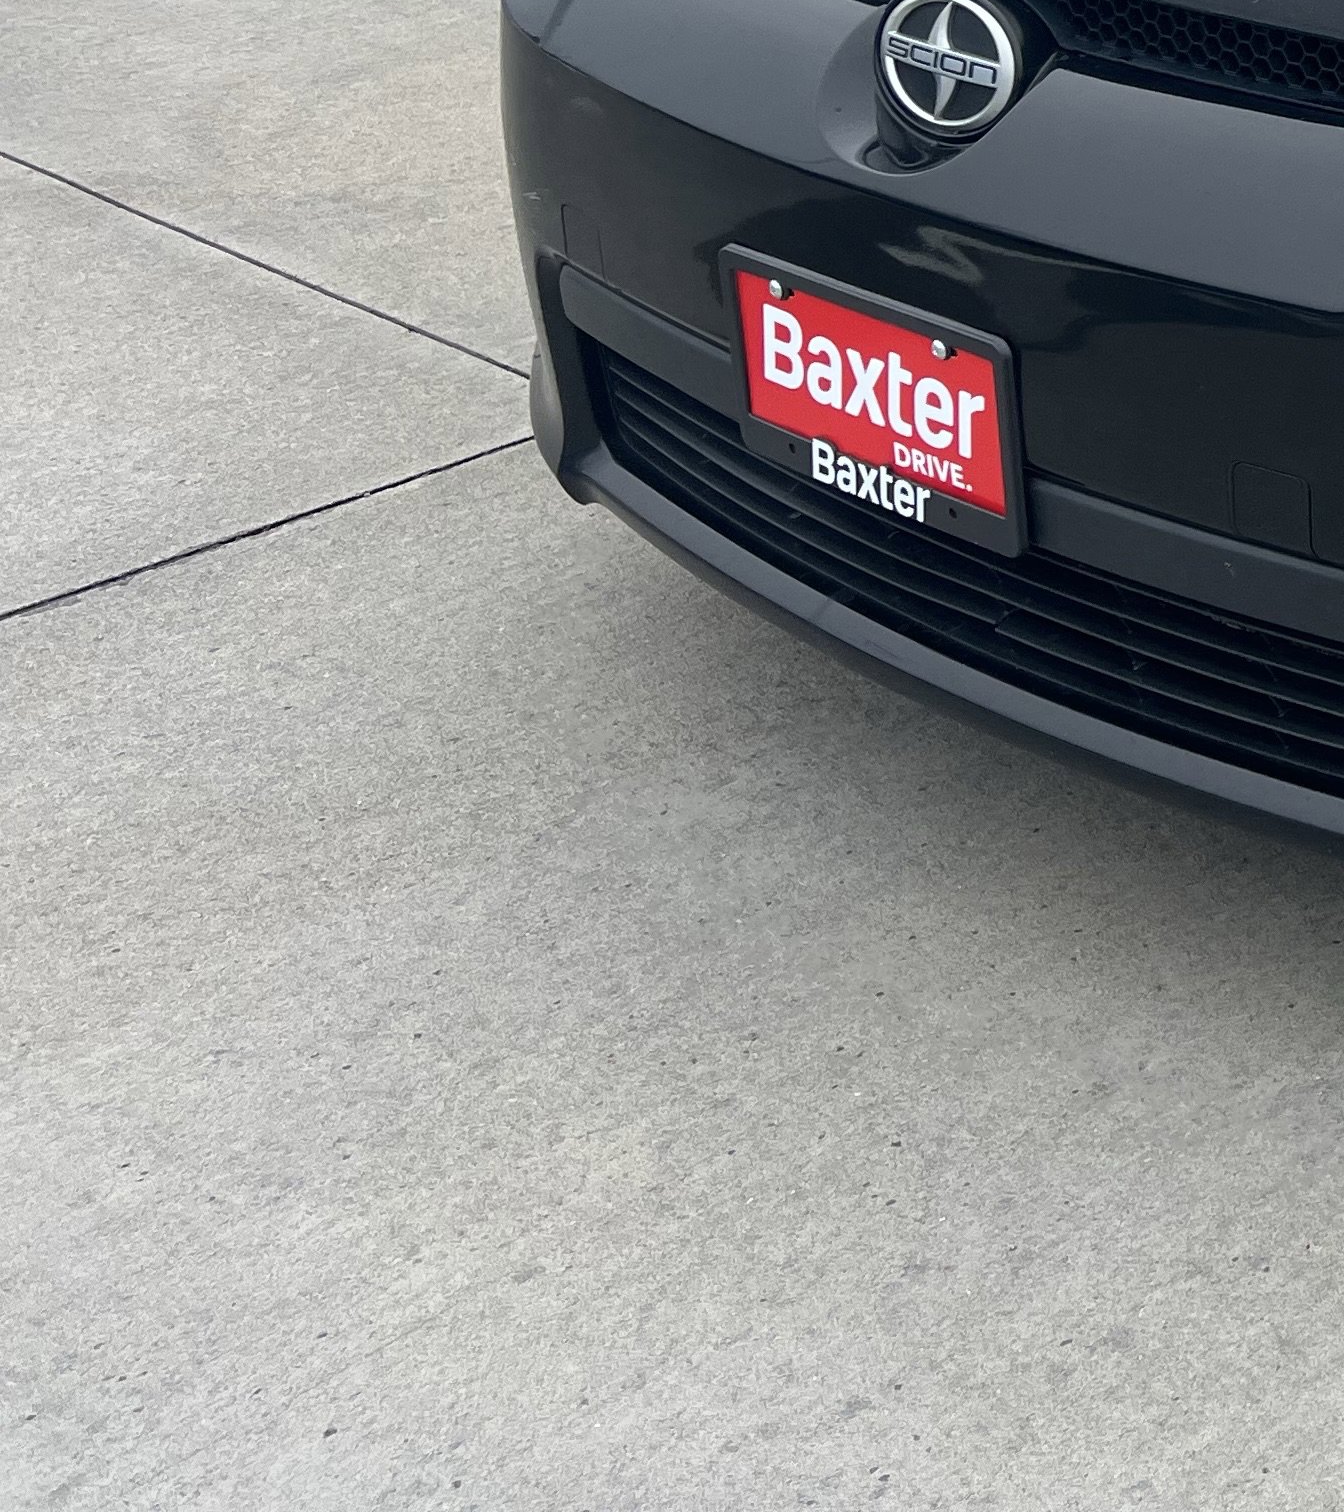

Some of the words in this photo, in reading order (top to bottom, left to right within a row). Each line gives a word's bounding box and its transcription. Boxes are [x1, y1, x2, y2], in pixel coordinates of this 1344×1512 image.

[761, 303, 985, 459] Baxter
[811, 437, 932, 524] Baxter
[893, 441, 974, 493] DRIVE.
